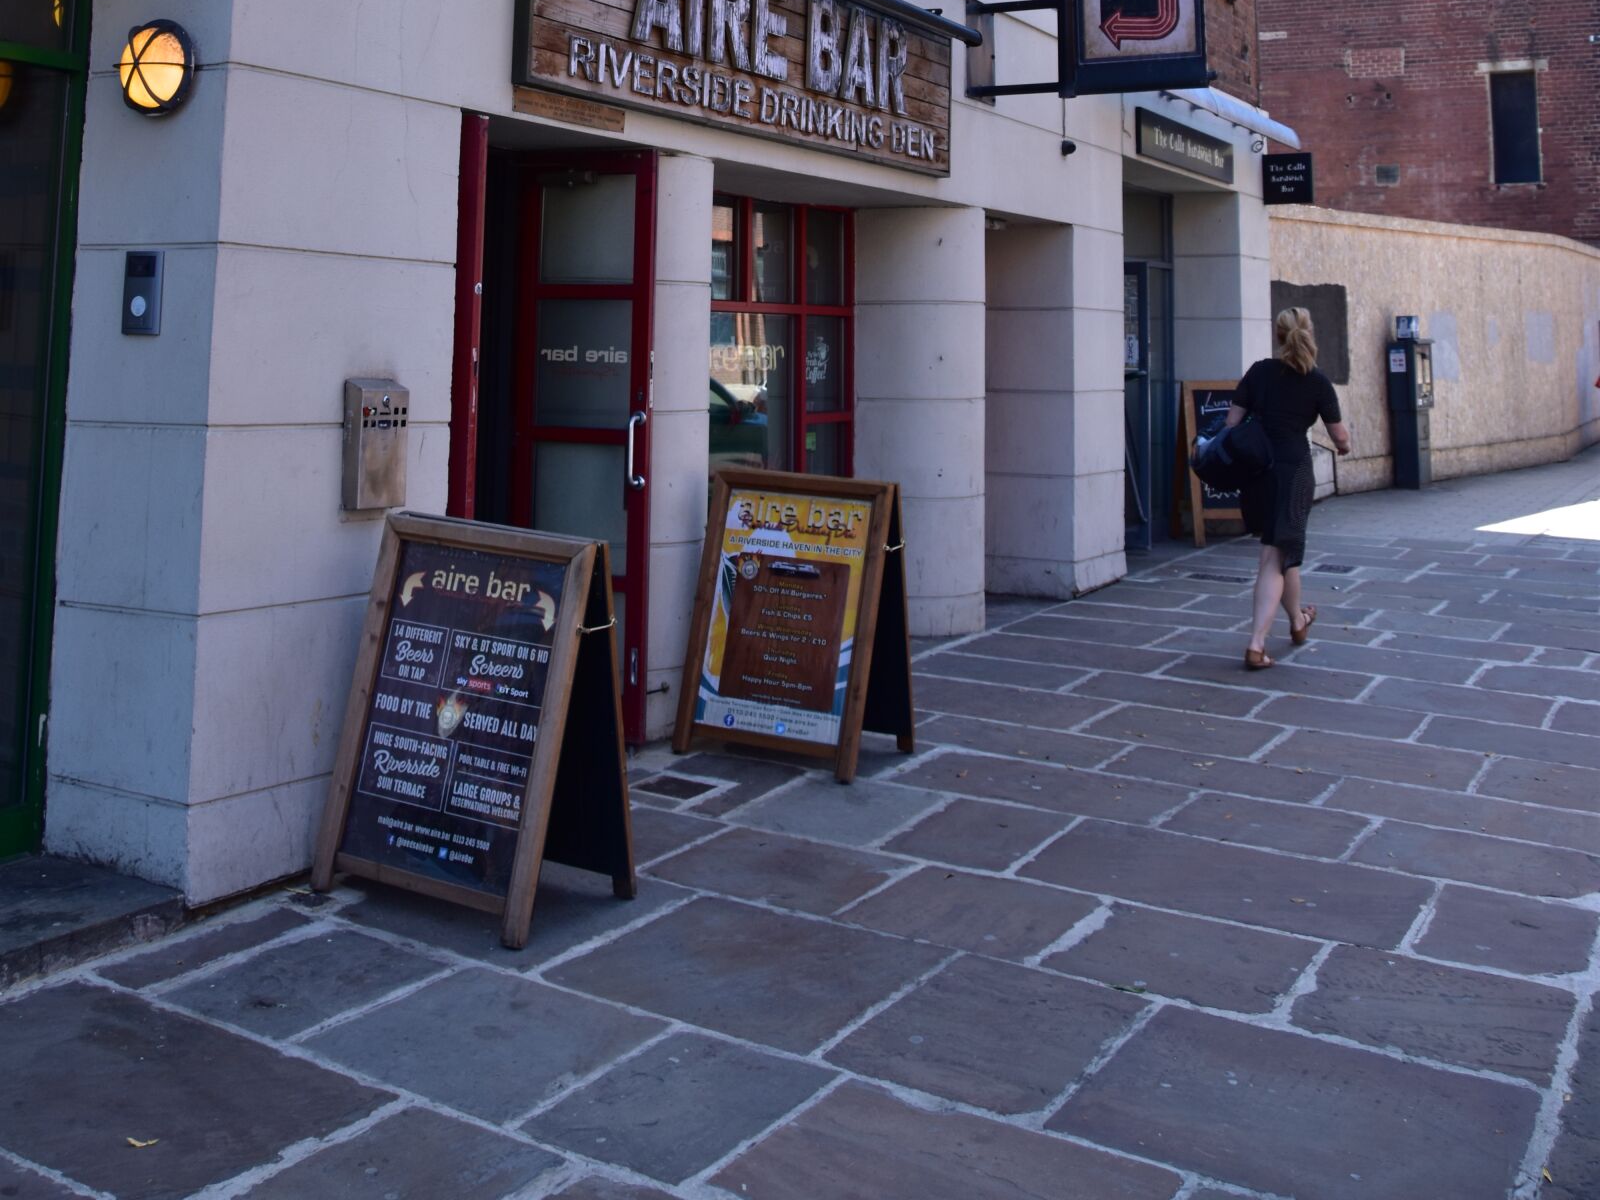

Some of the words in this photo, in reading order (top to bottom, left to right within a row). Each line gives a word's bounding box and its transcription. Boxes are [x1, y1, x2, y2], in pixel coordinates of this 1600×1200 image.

[567, 34, 753, 119] RIVERSIDE
[760, 87, 884, 148] DRINKING
[890, 122, 936, 162] DEN
[737, 496, 797, 526] aire
[807, 499, 863, 532] bar
[738, 536, 780, 548] RIVERSIDE
[782, 543, 811, 552] HAVEN
[813, 545, 822, 553] IN
[825, 546, 841, 555] THE
[843, 548, 863, 558] CITY
[432, 564, 480, 594] aire
[486, 571, 531, 601] bar
[394, 624, 403, 637] 14
[405, 625, 444, 644] DIFFERENT
[395, 640, 434, 664] Beers
[454, 635, 470, 649] SKY
[480, 640, 490, 653] BT
[491, 642, 516, 657] SPORT
[517, 647, 529, 660] ON
[537, 650, 549, 664] HD
[398, 664, 409, 677] ON
[410, 666, 425, 681] TAP
[469, 654, 524, 680] Screens
[456, 677, 468, 687] sky
[468, 680, 491, 690] sports
[510, 688, 529, 698] Sport
[375, 693, 399, 712] FOOD
[401, 699, 413, 715] BY
[415, 701, 433, 719] THE
[463, 712, 499, 734] SERVED
[500, 720, 518, 737] ALL
[520, 724, 537, 742] DAY
[373, 731, 393, 746] HUGE
[394, 735, 448, 759] SOUTH-FACING
[374, 750, 441, 778] Riverside
[458, 753, 473, 765] POOL
[474, 757, 490, 769] TABLE
[497, 762, 510, 774] FREE
[377, 776, 393, 790] SUN
[394, 780, 427, 798] TERRACE
[453, 781, 479, 799] LARGE
[479, 787, 512, 807] GROUPS
[451, 796, 491, 814] RESERVATIONS
[491, 805, 520, 821] WELCOME
